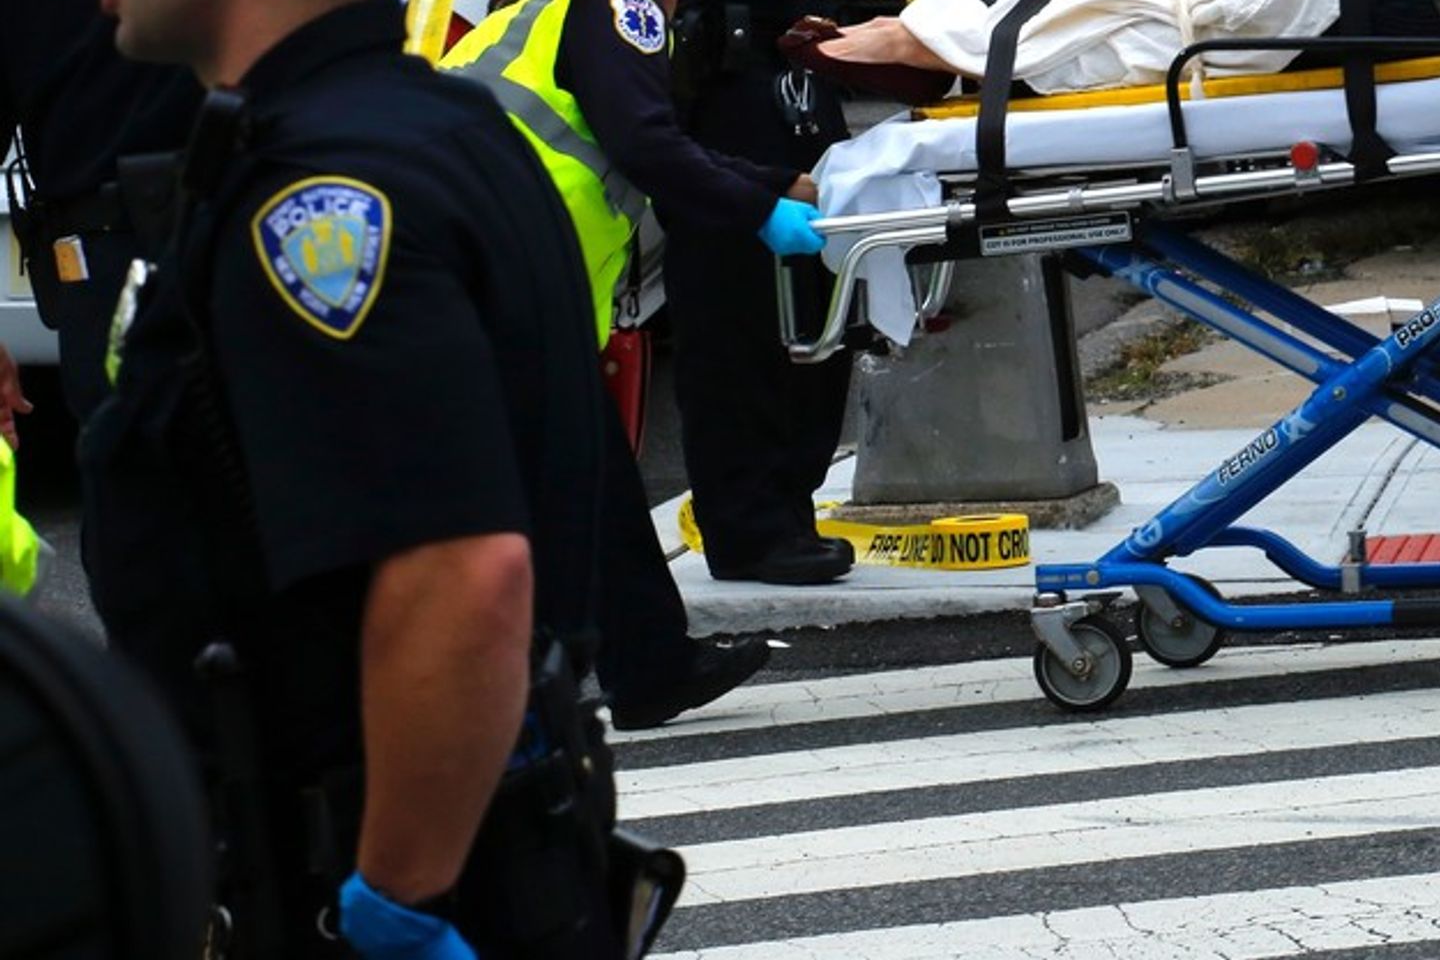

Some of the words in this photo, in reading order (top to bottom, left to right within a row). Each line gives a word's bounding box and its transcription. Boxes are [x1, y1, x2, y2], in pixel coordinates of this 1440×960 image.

[266, 197, 371, 238] POLICE
[1217, 428, 1278, 486] FERNO
[950, 531, 992, 564] NOT
